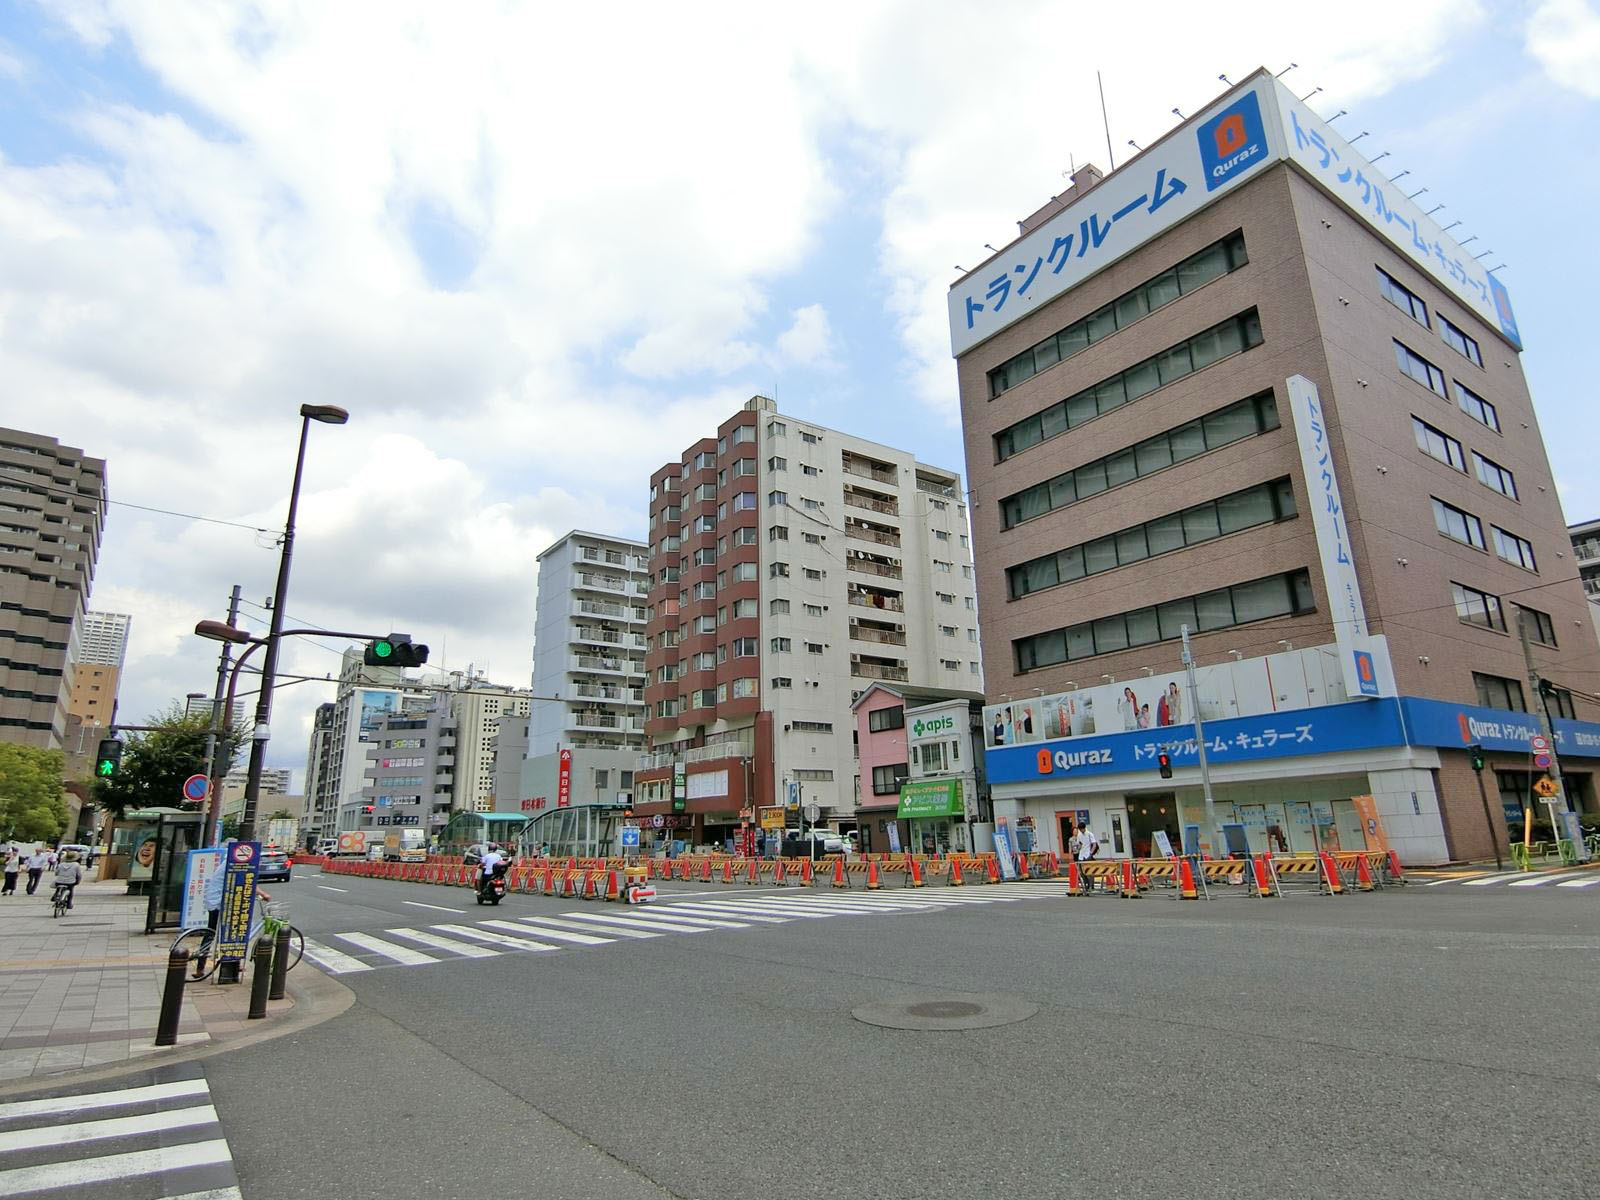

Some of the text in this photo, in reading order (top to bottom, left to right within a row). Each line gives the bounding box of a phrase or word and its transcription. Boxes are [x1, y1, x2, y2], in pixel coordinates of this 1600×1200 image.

[1212, 144, 1259, 178] Quraz
[1291, 110, 1492, 307] トランクルーム・キュラーズ
[965, 168, 1188, 329] トランクルーム
[1307, 396, 1350, 566] トランクルーム
[926, 715, 954, 734] apis
[1468, 716, 1502, 740] Quraz
[1055, 748, 1113, 770] Quraz
